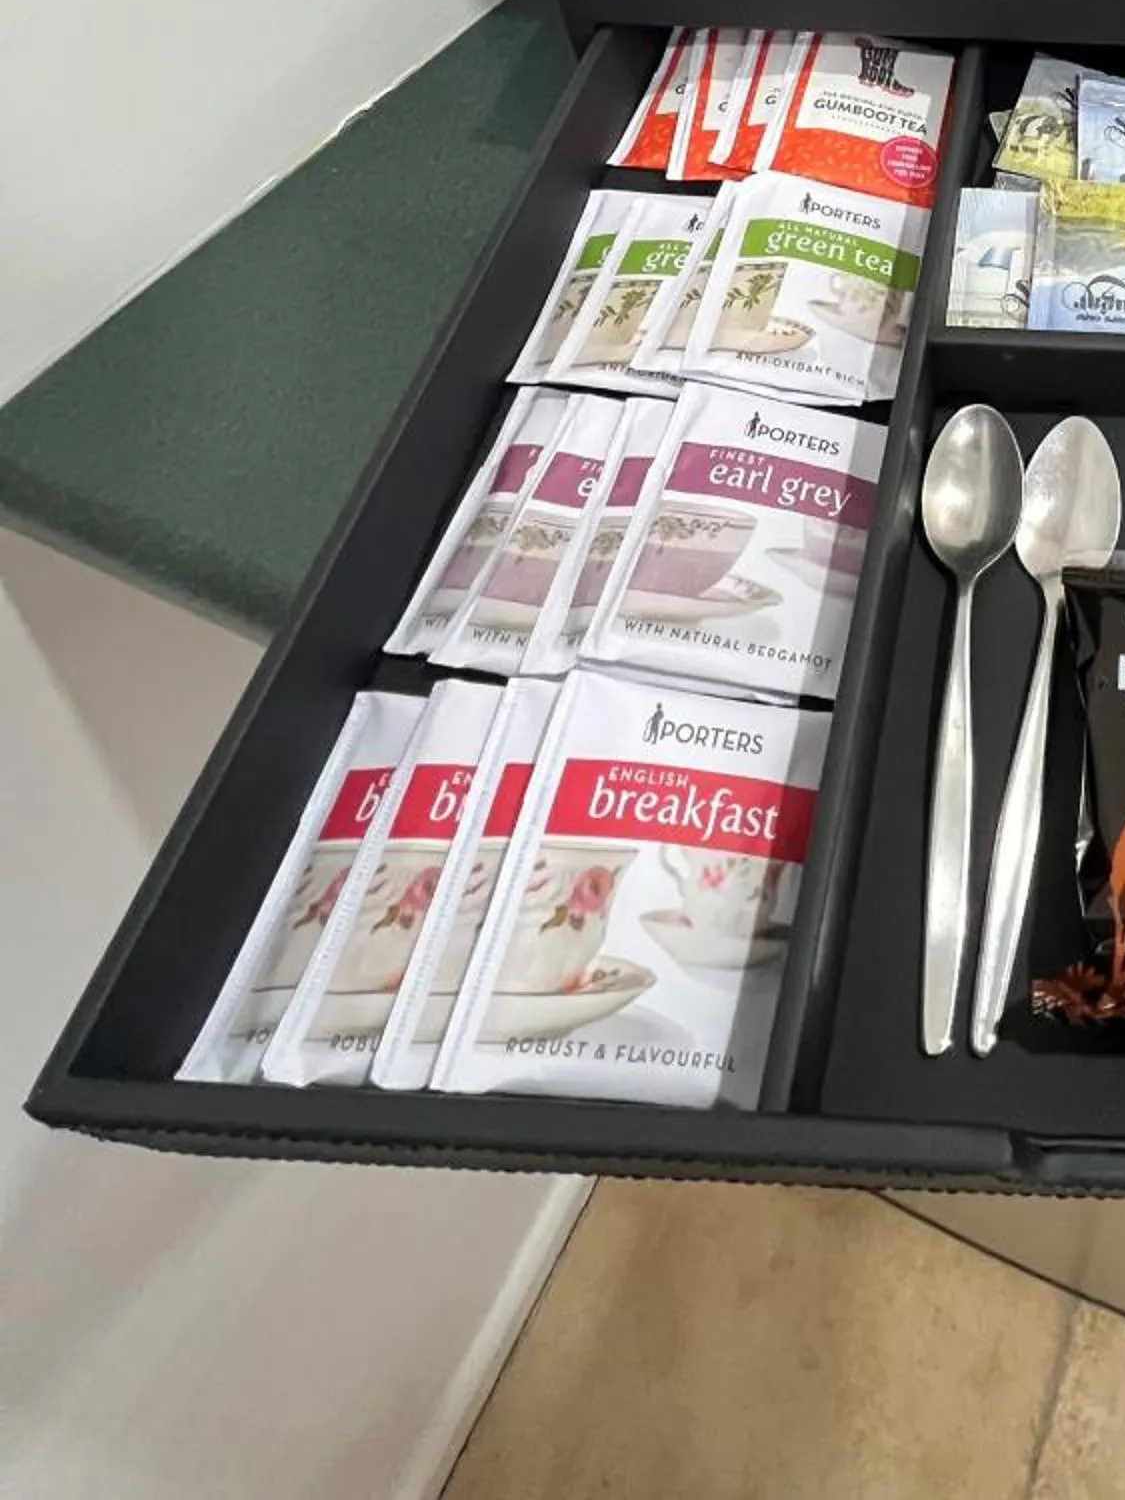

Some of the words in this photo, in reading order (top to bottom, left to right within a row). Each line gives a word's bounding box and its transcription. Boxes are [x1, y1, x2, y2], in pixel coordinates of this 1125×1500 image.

[814, 98, 898, 124] GUMBOOT
[899, 117, 927, 135] TEA
[810, 202, 881, 230] PORTERS
[642, 250, 689, 273] gre
[765, 231, 845, 261] green
[854, 248, 893, 277] tea
[758, 423, 840, 455] PORTERS
[708, 448, 766, 467] FINEST
[709, 462, 773, 494] earl
[777, 476, 852, 517] grey
[624, 619, 666, 637] WITH
[669, 627, 741, 651] NATURAL
[747, 643, 833, 670] BERGAMOT
[660, 720, 765, 755] PORTERS
[608, 765, 691, 789] ENGLISH
[588, 775, 780, 841] breakfast
[505, 1036, 589, 1060] ROBUST
[615, 1044, 737, 1073] FLAVOURFUL
